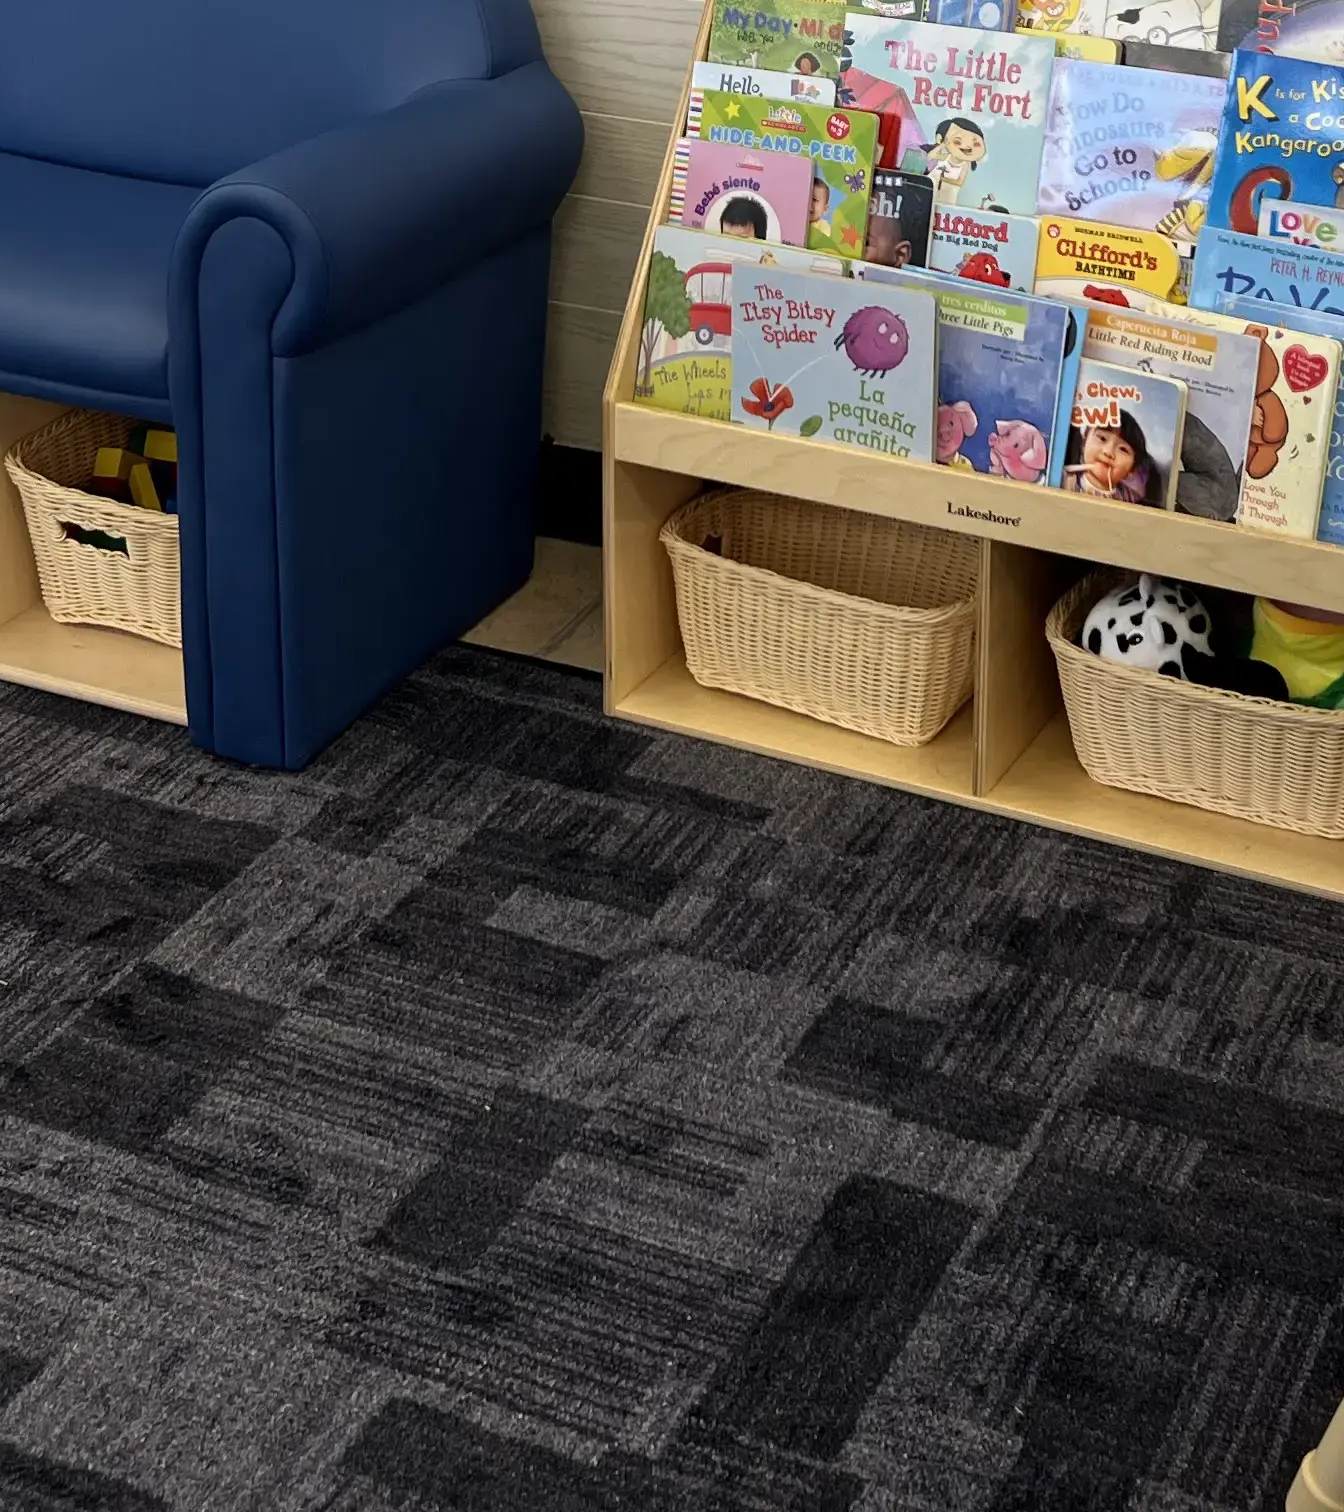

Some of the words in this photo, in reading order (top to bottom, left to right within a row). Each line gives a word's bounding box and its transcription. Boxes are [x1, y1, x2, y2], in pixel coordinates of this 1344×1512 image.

[885, 40, 939, 72] The
[944, 48, 1021, 85] Little
[913, 76, 962, 109] Red
[977, 82, 1033, 120] Fort
[1235, 74, 1279, 124] K
[1288, 114, 1300, 125] a
[709, 126, 857, 164] HIDE-AND-PEEK
[1234, 133, 1344, 159] Kangaroo
[1073, 155, 1108, 177] Go
[1112, 147, 1138, 166] to
[1064, 170, 1152, 213] School?
[1056, 238, 1158, 271] Clifford's
[1075, 261, 1136, 282] BATHTIME
[755, 284, 784, 301] The
[740, 301, 781, 323] Itsy
[786, 300, 836, 328] Bitsy
[763, 326, 817, 350] Spider
[1087, 328, 1117, 346] Little
[1119, 333, 1140, 351] Red
[1142, 338, 1180, 362] Riding
[1181, 348, 1213, 368] Hood
[859, 381, 885, 404] La
[1086, 382, 1142, 402] Chew,
[827, 399, 916, 440] pequeña
[833, 425, 911, 458] arañita
[947, 501, 1020, 527] Lakeshore
